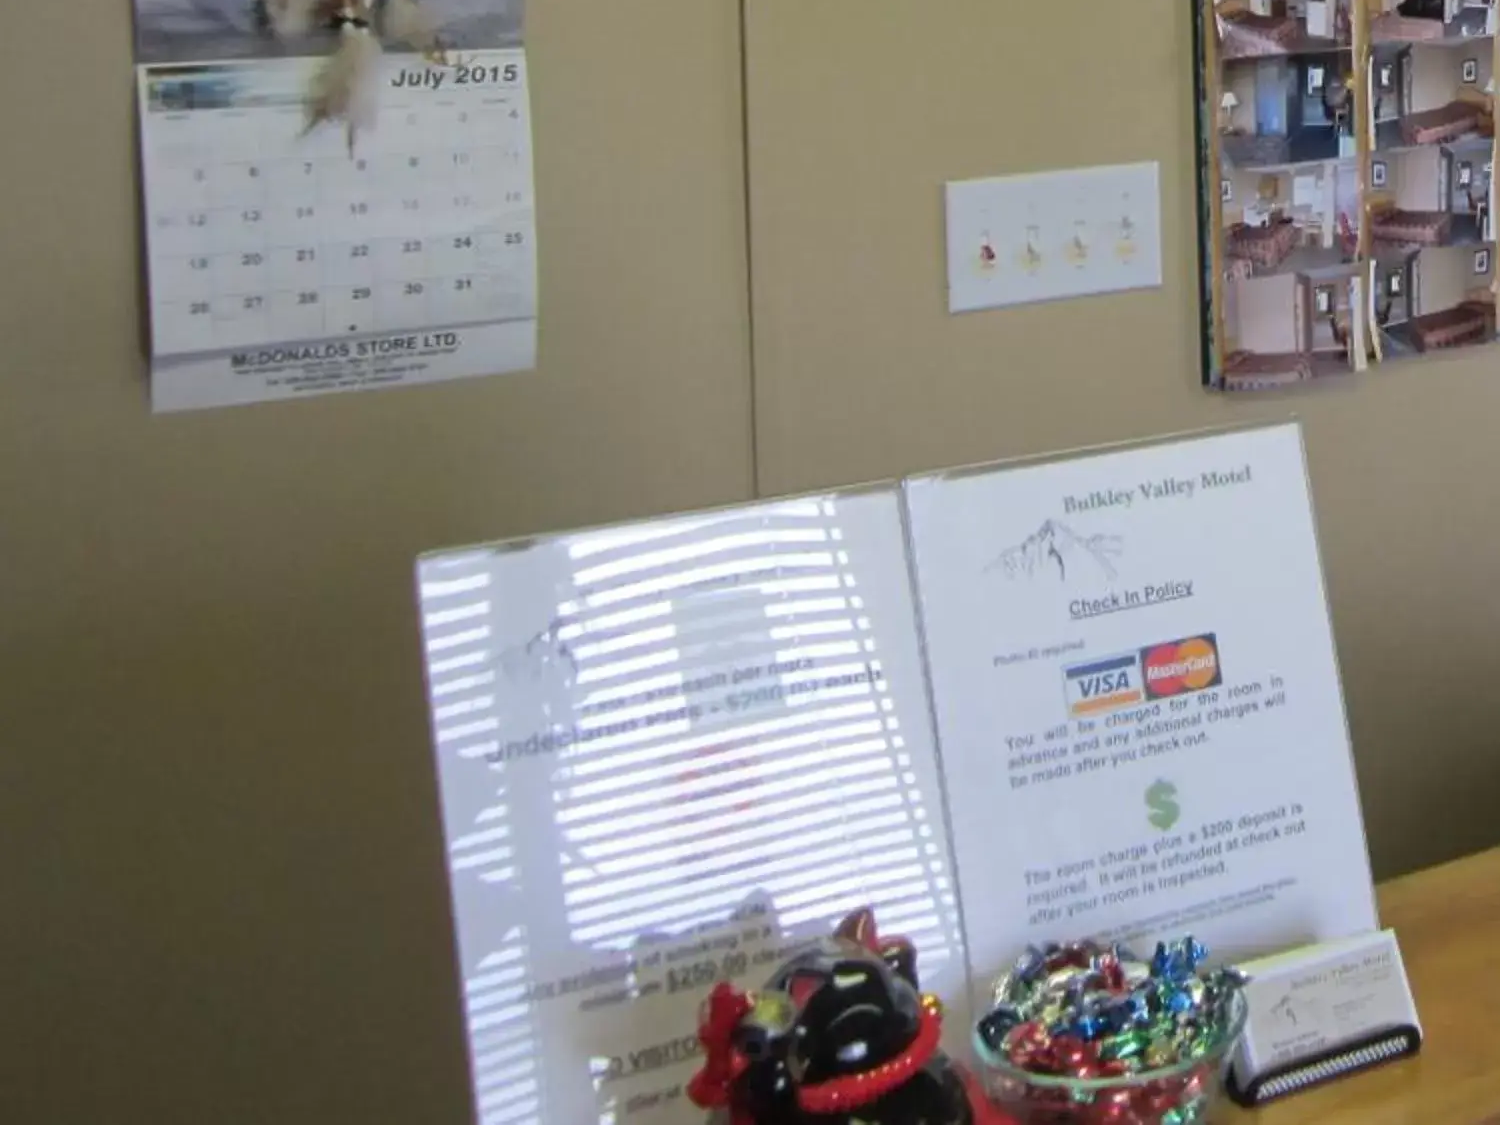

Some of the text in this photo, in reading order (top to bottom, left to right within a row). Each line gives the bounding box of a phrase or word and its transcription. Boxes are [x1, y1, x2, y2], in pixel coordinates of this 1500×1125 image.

[392, 64, 518, 90] July 2015
[231, 341, 350, 367] McDONALDS
[356, 336, 417, 356] STORE
[1063, 464, 1252, 515] Bulkley Valley Motel
[1069, 579, 1194, 618] Check In Policy
[1078, 671, 1130, 697] VISA
[1004, 734, 1034, 751] You
[1044, 725, 1068, 742] will
[1078, 719, 1095, 732] be
[1105, 705, 1160, 726] charged
[1169, 697, 1188, 712] for
[1197, 690, 1218, 705] the
[1227, 682, 1262, 699] room
[1008, 692, 1286, 770] advance and any additional charges will
[1009, 773, 1027, 789] be
[1031, 765, 1072, 783] made
[1076, 755, 1107, 775] after
[1111, 749, 1136, 767] you
[1140, 738, 1179, 758] check
[1024, 867, 1051, 887] The
[1056, 858, 1096, 879] room
[1100, 845, 1148, 868] charge
[1152, 832, 1183, 854] plus
[1201, 819, 1234, 840] $200
[1237, 807, 1287, 830] deposit
[1113, 865, 1137, 883] will
[1140, 860, 1158, 875] be
[1161, 843, 1222, 870] refunded
[1225, 837, 1239, 851] at
[1241, 827, 1281, 848] check
[1284, 820, 1306, 836] out
[1028, 905, 1062, 926] after
[1066, 895, 1099, 918] your
[1102, 884, 1139, 905] room
